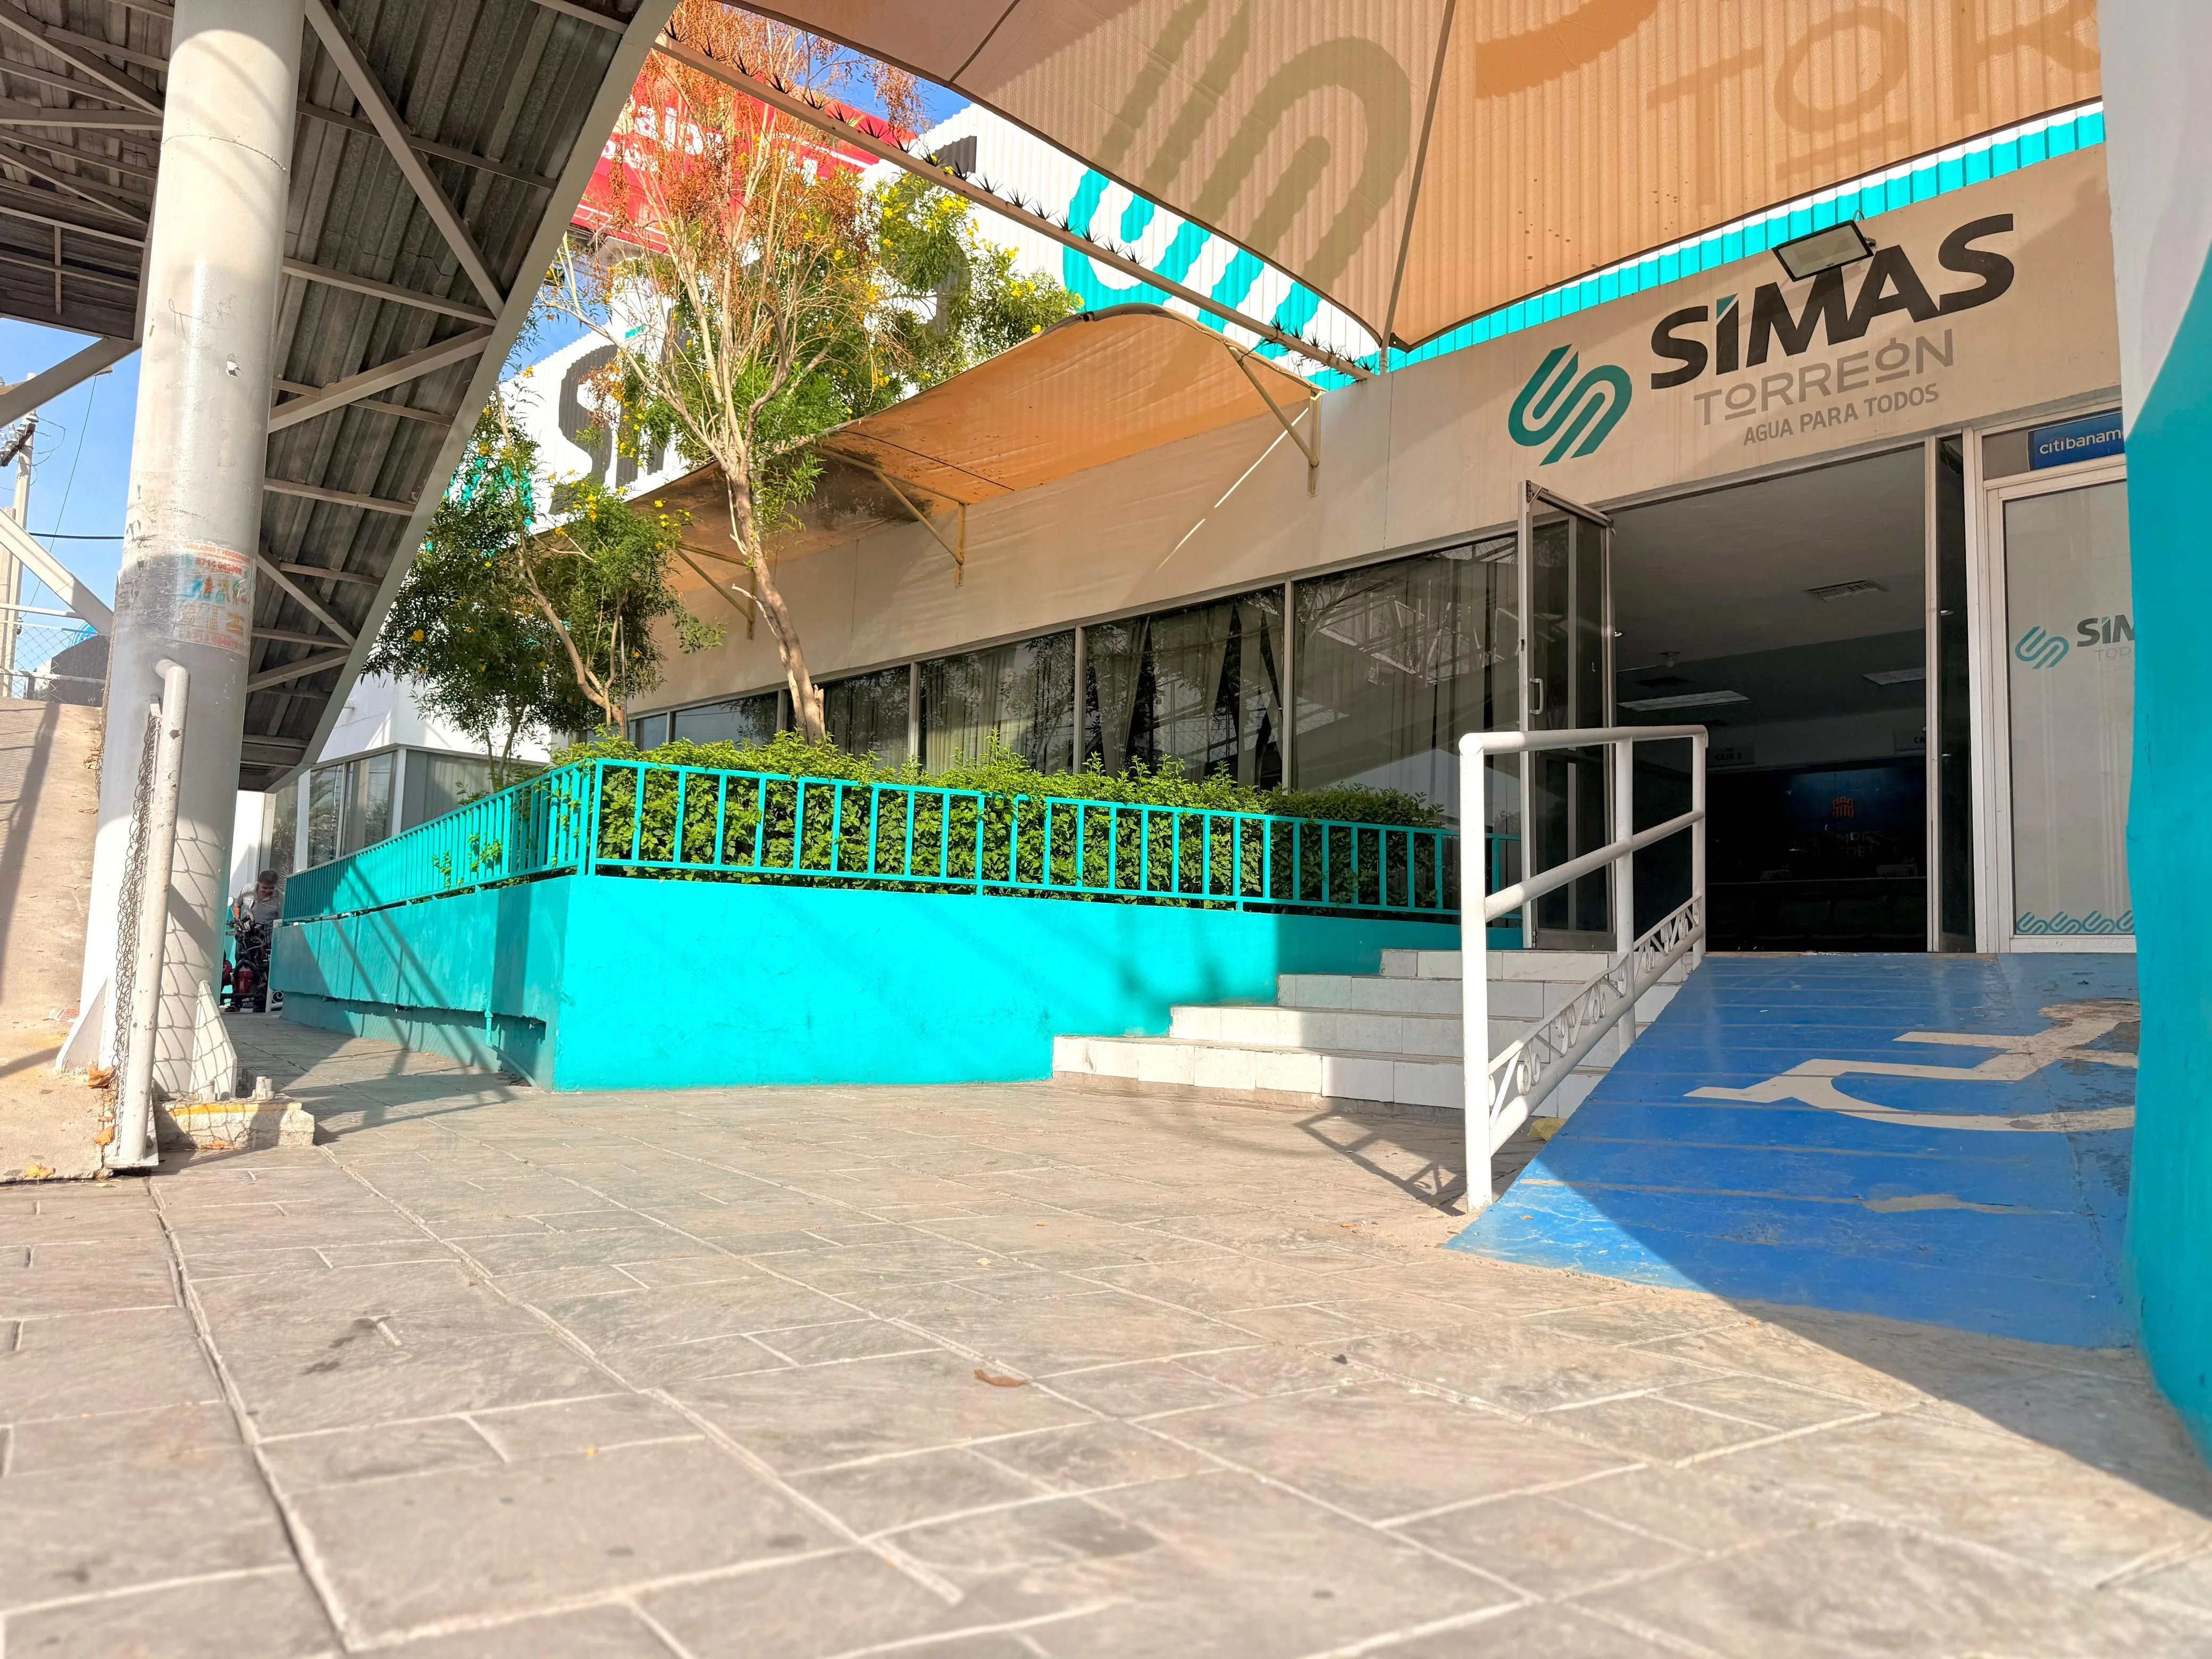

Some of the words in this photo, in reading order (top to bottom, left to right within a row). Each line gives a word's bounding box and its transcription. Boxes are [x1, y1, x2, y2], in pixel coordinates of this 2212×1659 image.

[1694, 328, 1955, 426] TORREÓN
[1743, 417, 1794, 446] AGUA
[1799, 403, 1859, 432] PARA
[1863, 382, 1939, 417] TODOS
[2039, 429, 2124, 455] citibanam
